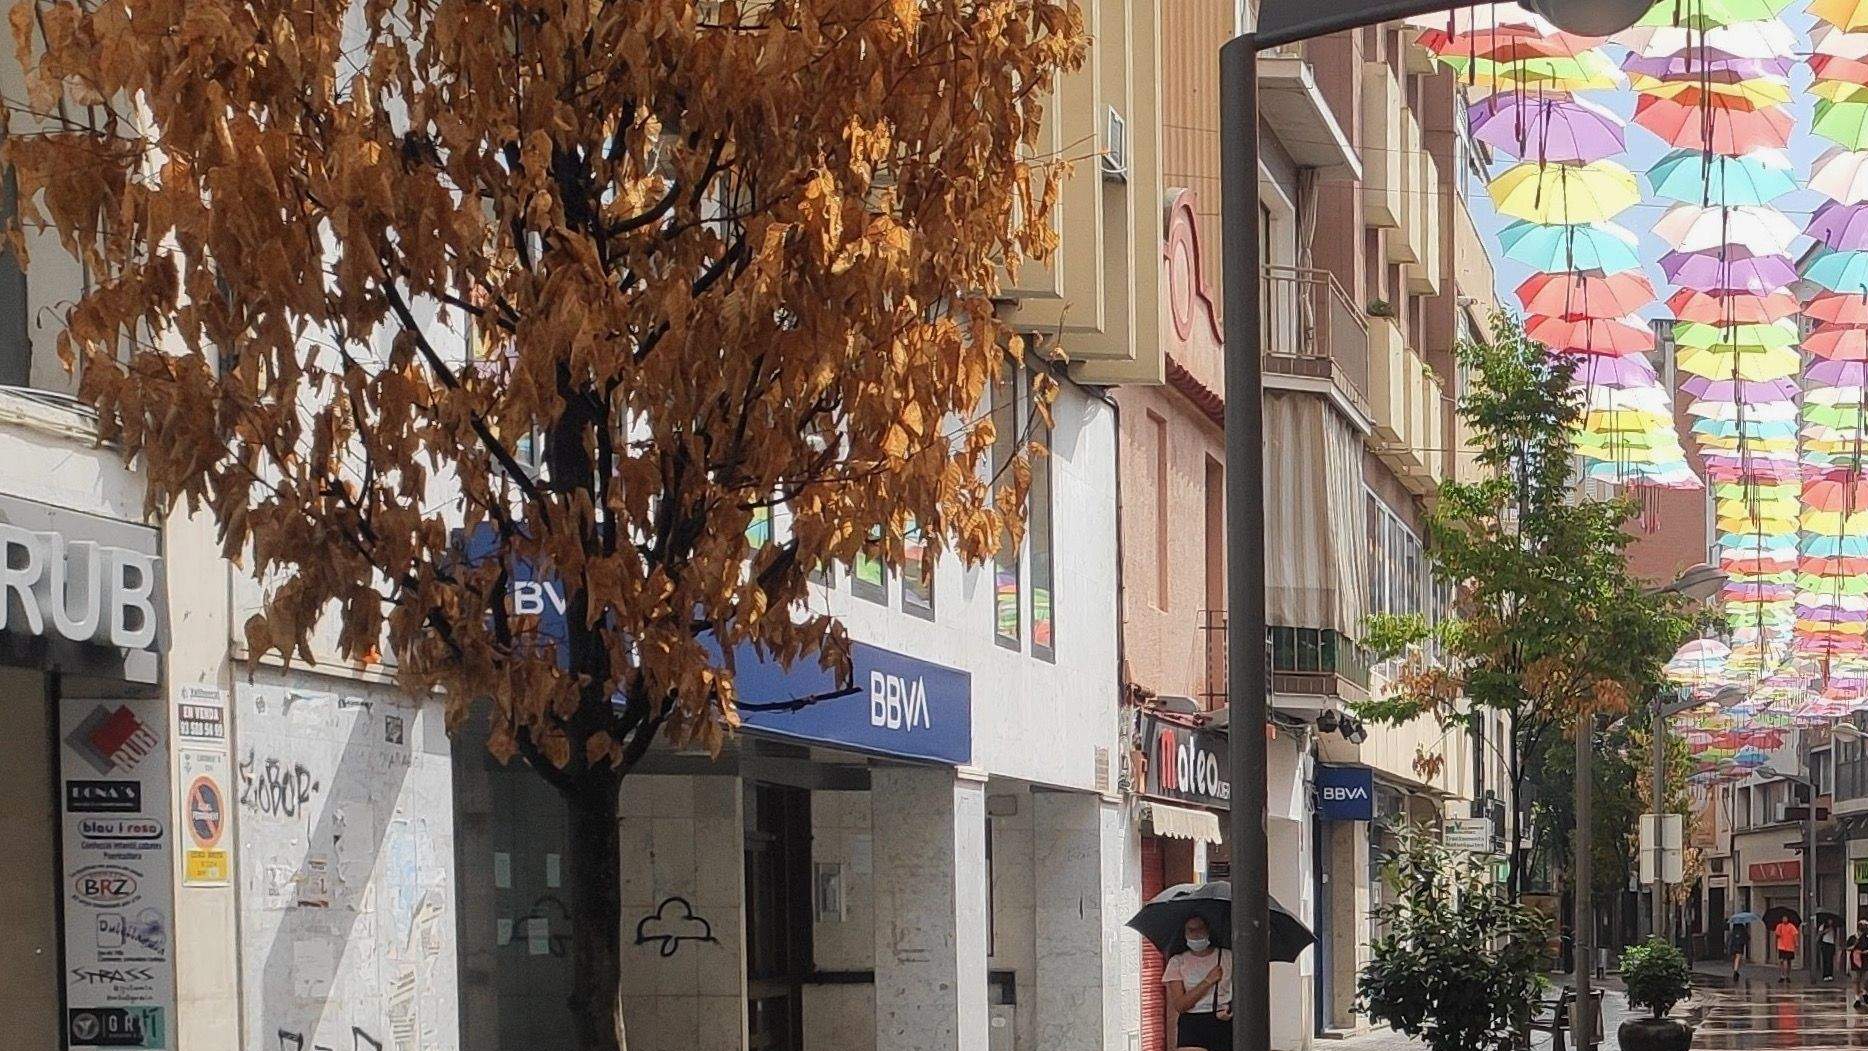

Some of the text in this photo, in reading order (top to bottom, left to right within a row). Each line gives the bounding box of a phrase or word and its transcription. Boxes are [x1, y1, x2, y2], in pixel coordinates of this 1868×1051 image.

[870, 670, 930, 732] BBVA
[1323, 786, 1368, 800] BBVA
[127, 824, 157, 834] rosa
[84, 879, 131, 897] BRZ
[70, 966, 155, 985] STRASS
